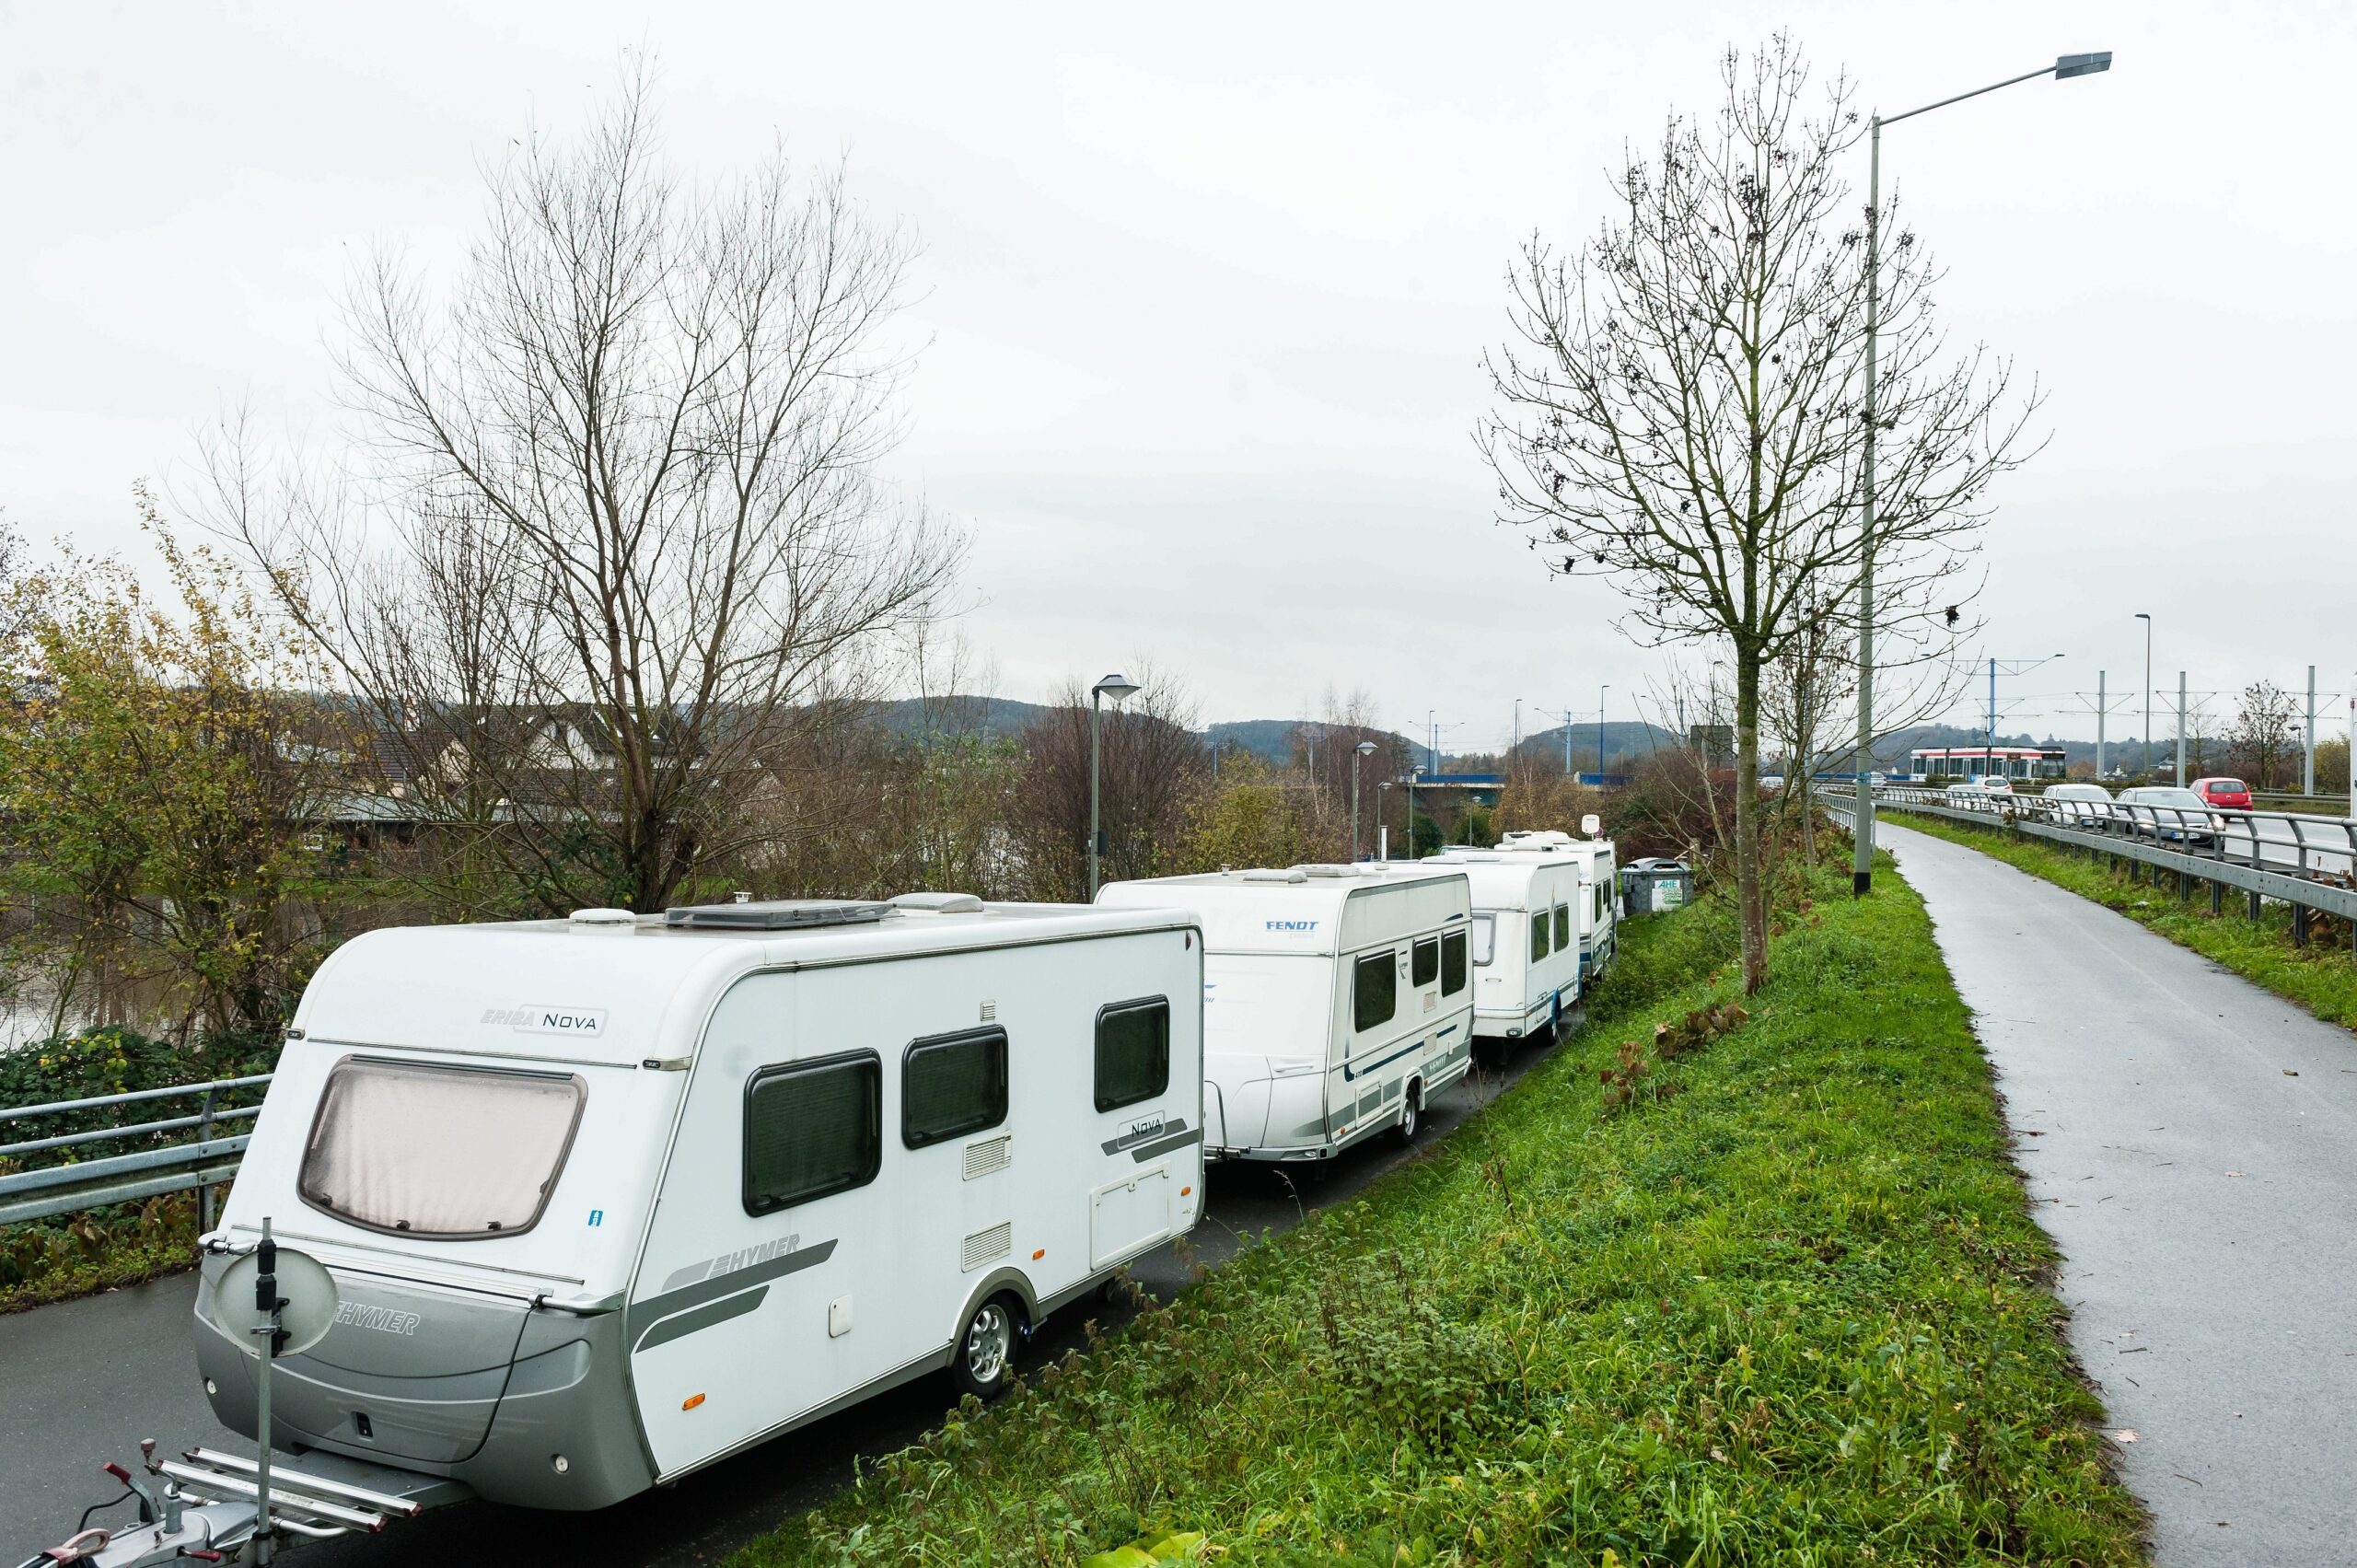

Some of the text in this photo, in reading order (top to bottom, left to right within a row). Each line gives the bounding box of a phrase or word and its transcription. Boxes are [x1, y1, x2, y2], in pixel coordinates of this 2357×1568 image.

[1266, 921, 1319, 930] FENDT
[480, 1008, 536, 1027] ERIBA
[728, 1233, 801, 1272] HYMER
[335, 1302, 421, 1336] HYMER
